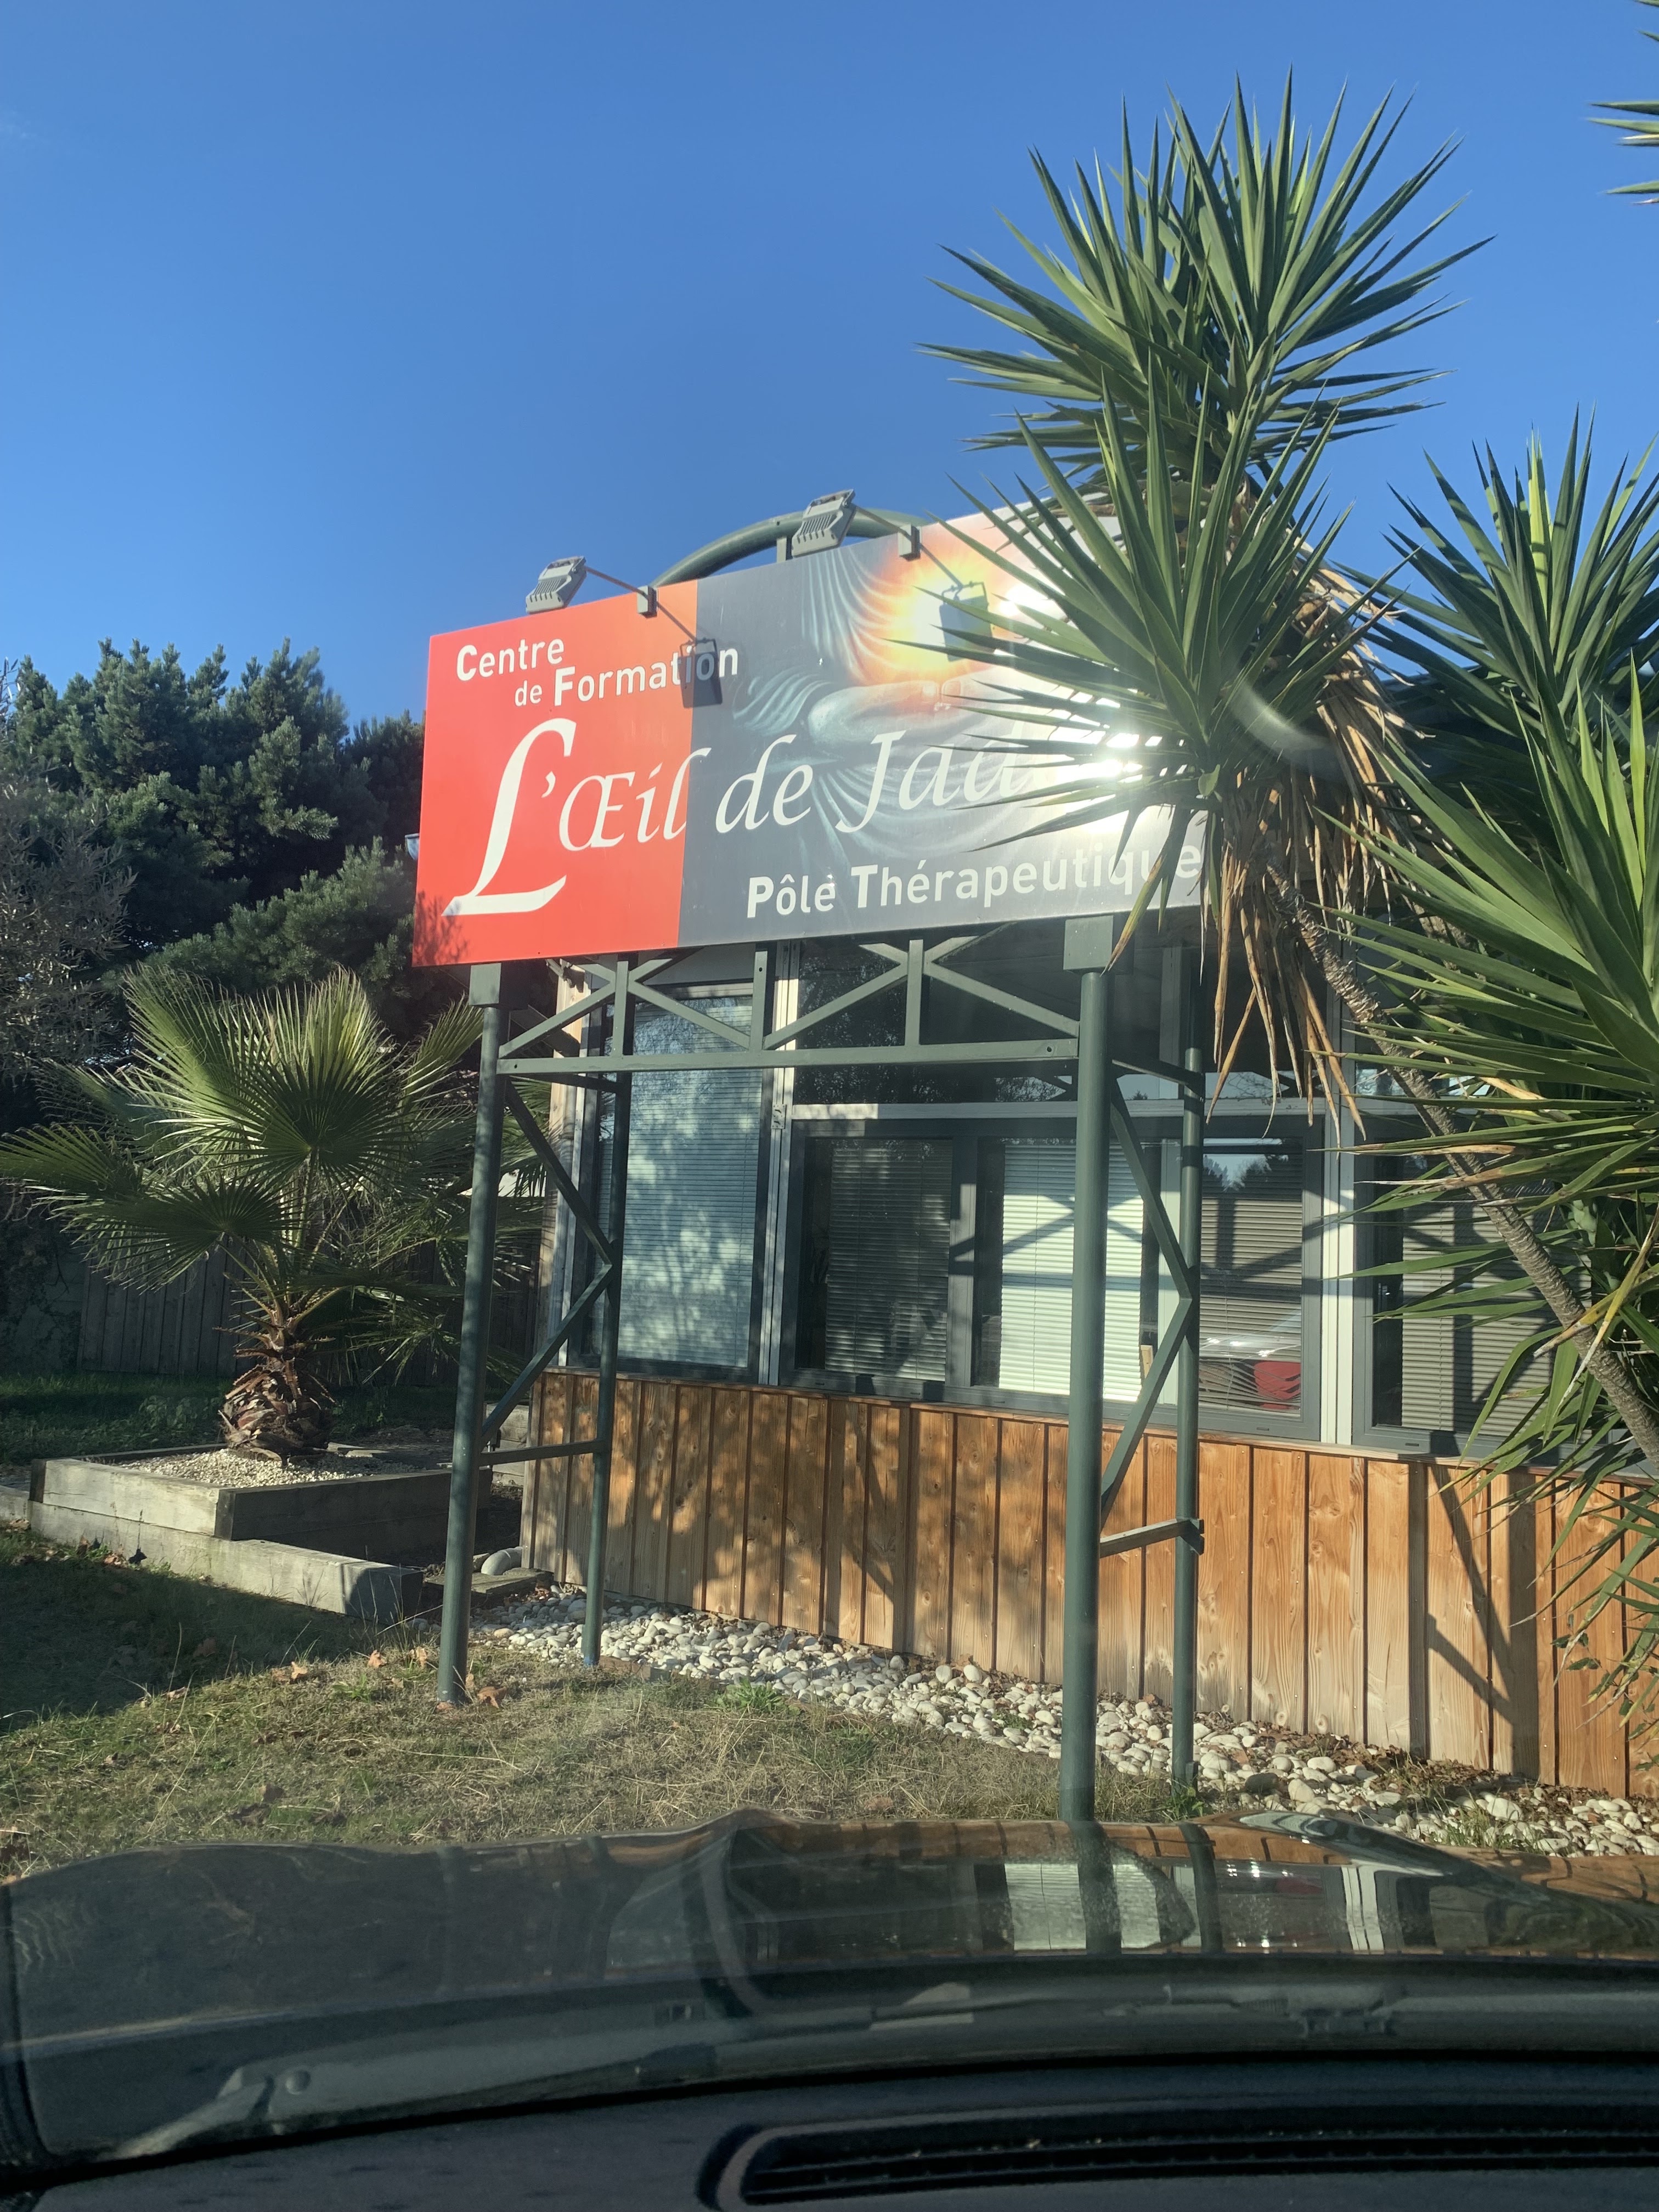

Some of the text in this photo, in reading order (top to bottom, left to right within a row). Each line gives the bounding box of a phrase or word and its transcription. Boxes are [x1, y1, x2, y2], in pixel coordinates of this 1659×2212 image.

[456, 638, 565, 681] Centre
[514, 645, 738, 707] de Formation
[715, 733, 814, 834] de
[834, 708, 1059, 833] Jad
[747, 873, 836, 918] Pôle
